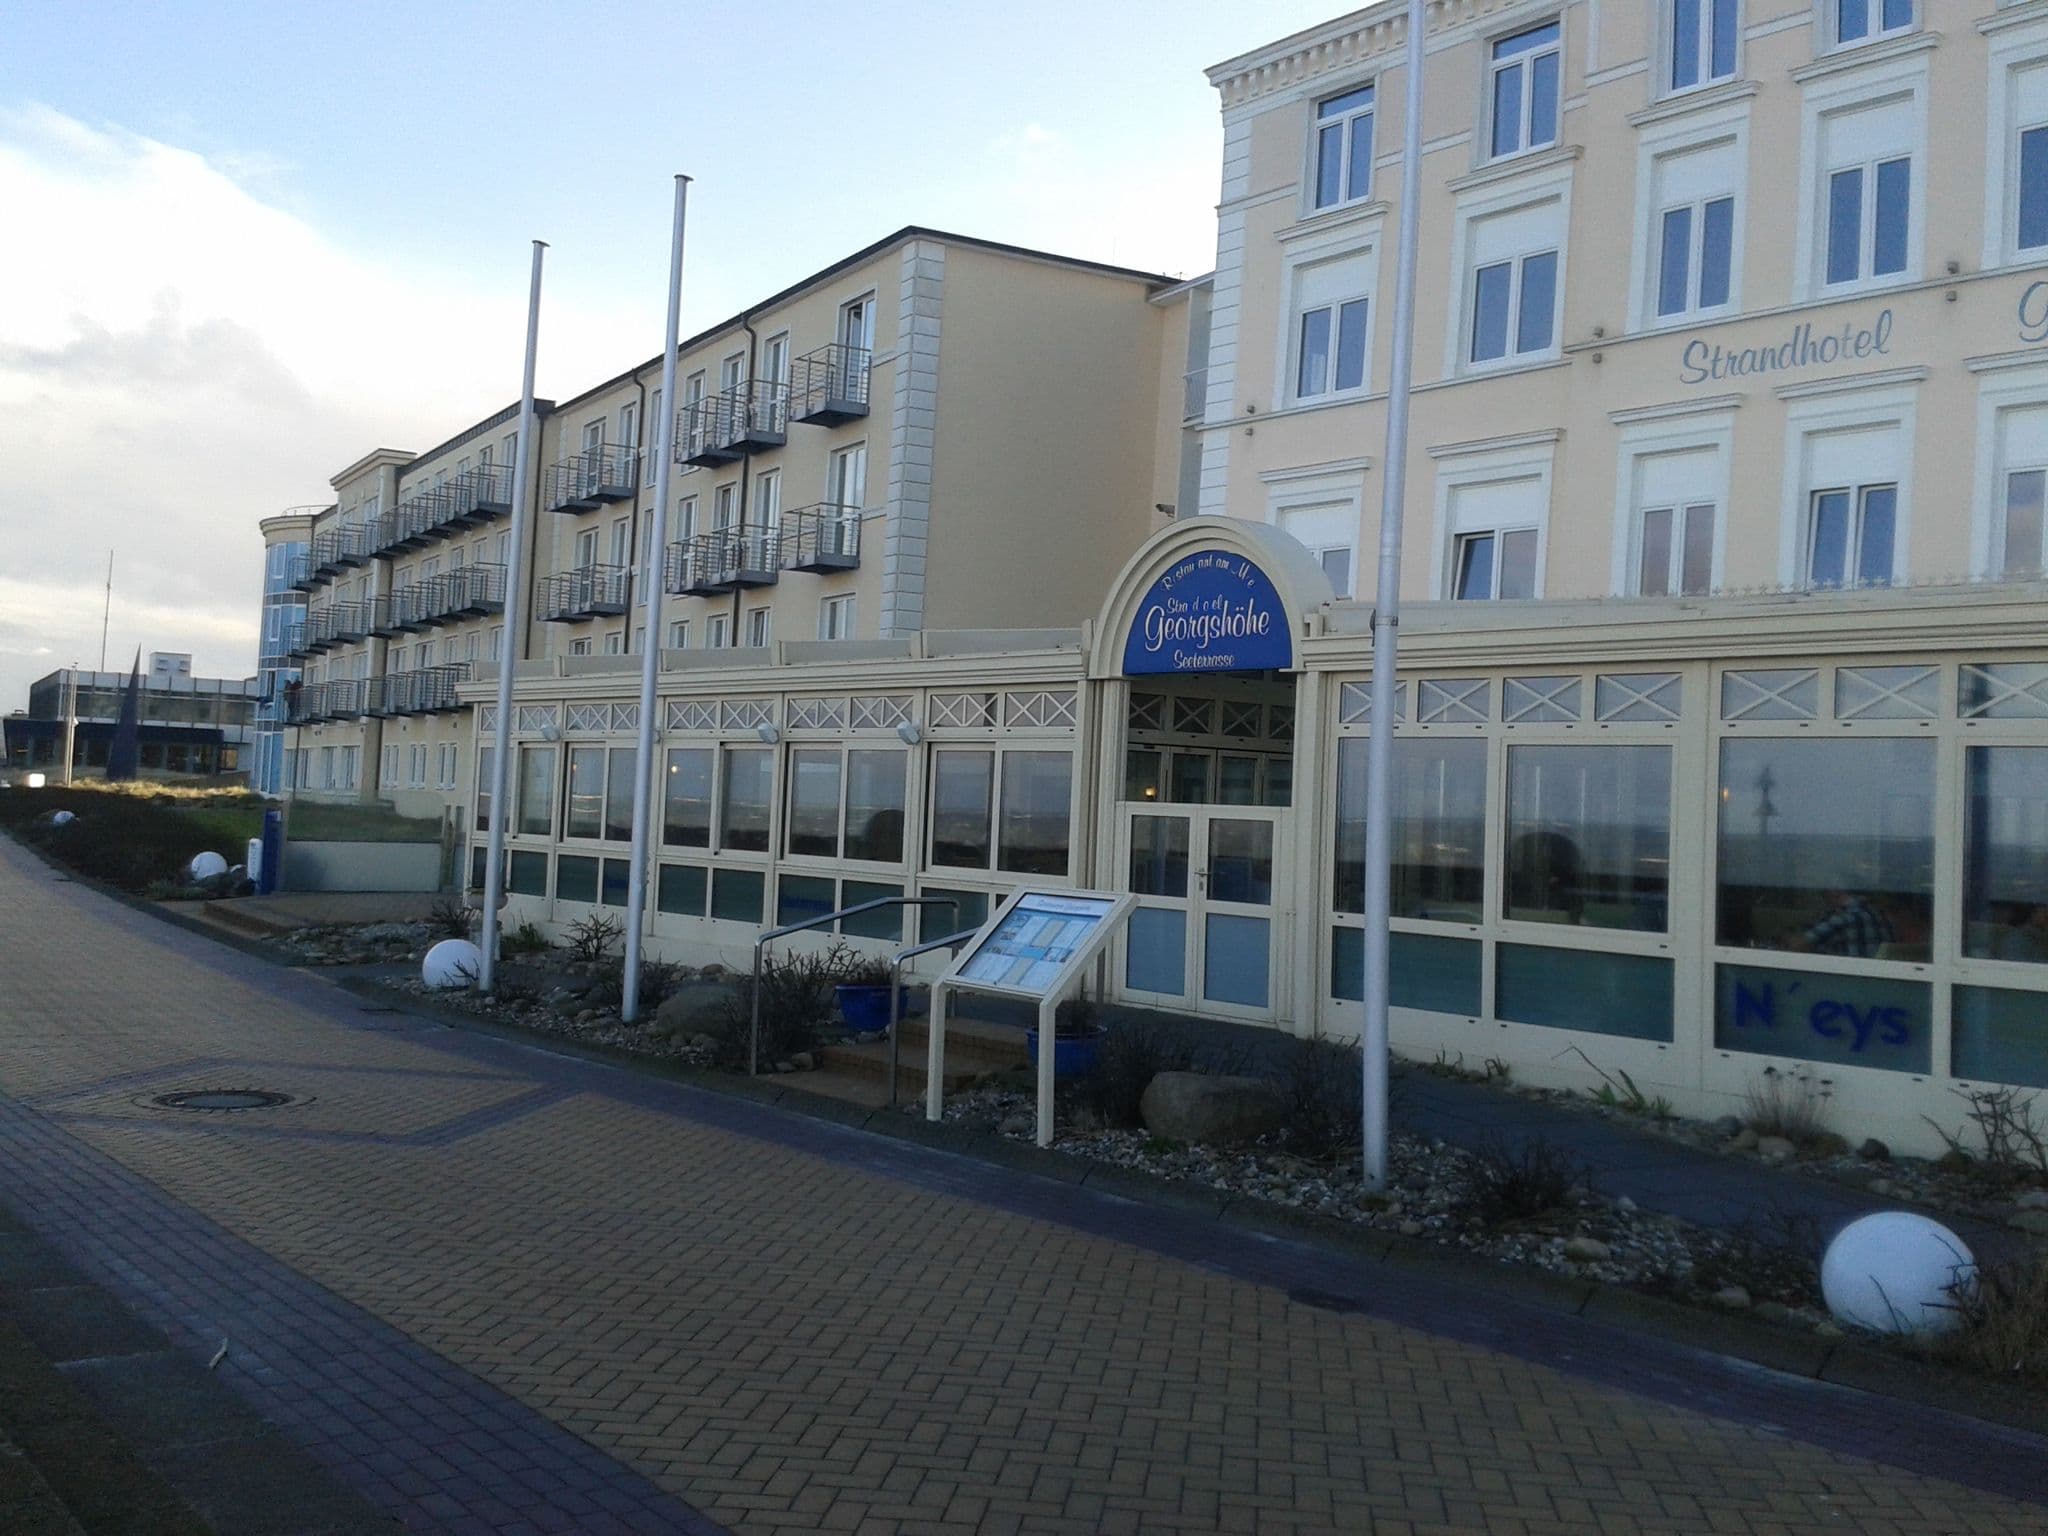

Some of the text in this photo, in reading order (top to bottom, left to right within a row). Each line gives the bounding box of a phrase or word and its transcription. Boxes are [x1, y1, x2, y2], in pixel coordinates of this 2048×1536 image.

[1679, 309, 1894, 385] Strandhotel
[1161, 554, 1213, 591] Rstauant
[1167, 593, 1223, 614] Stradoel
[1144, 597, 1270, 652] Georgshöhe
[1173, 648, 1235, 670] Seeterrasse
